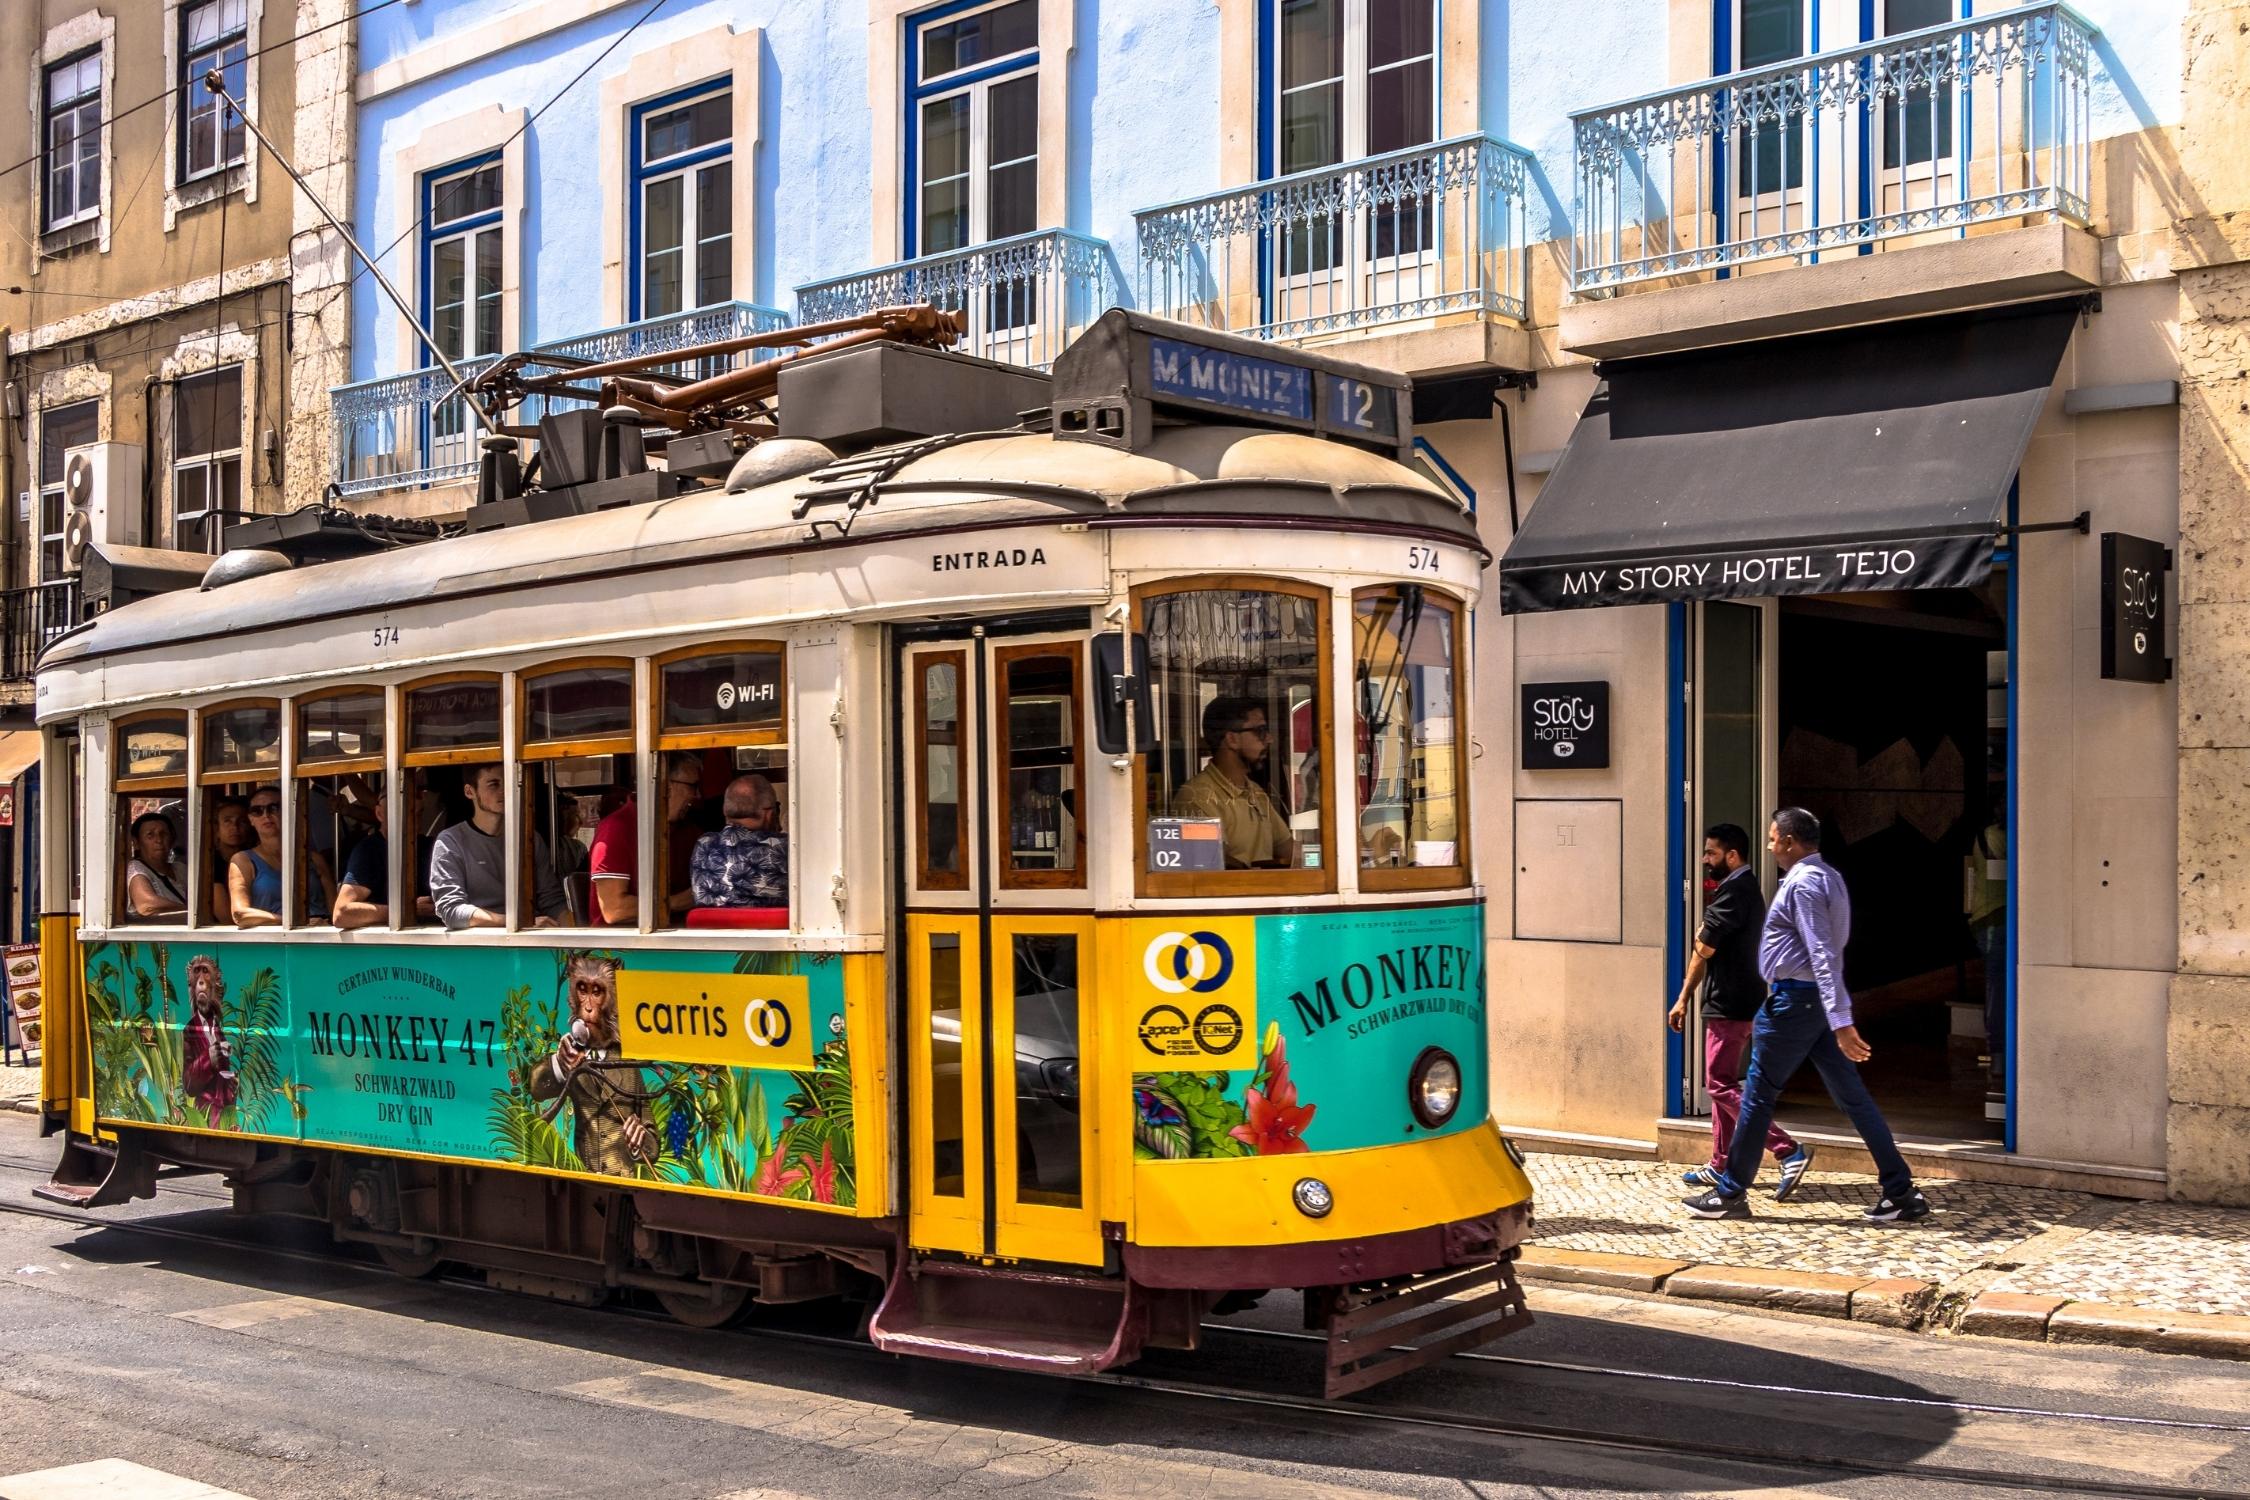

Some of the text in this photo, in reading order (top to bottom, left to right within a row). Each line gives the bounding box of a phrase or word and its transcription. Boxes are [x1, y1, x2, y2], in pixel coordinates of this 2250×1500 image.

[1338, 379, 1374, 428] 12
[932, 548, 1047, 572] ENTRADA
[1409, 546, 1439, 572] 574
[1562, 550, 1916, 595] MY STORY HOTEL TEJO
[2123, 567, 2158, 619] Story
[373, 626, 400, 647] 574
[738, 683, 774, 702] WI-FI
[1533, 697, 1594, 732] Story
[1533, 728, 1579, 741] HOTEL
[1155, 828, 1181, 840] 12E
[1155, 850, 1182, 868] 02
[338, 966, 456, 1001] CERTAINLY WUNDERBAR
[1288, 945, 1472, 1036] MONKEY
[635, 992, 728, 1038] carris
[1346, 997, 1447, 1039] SCHWARZWALD
[1450, 998, 1467, 1016] DRY
[308, 1011, 496, 1068] MONKEY 47
[354, 1072, 456, 1100] SCHWARZWALD
[378, 1102, 433, 1126] DRY GIN
